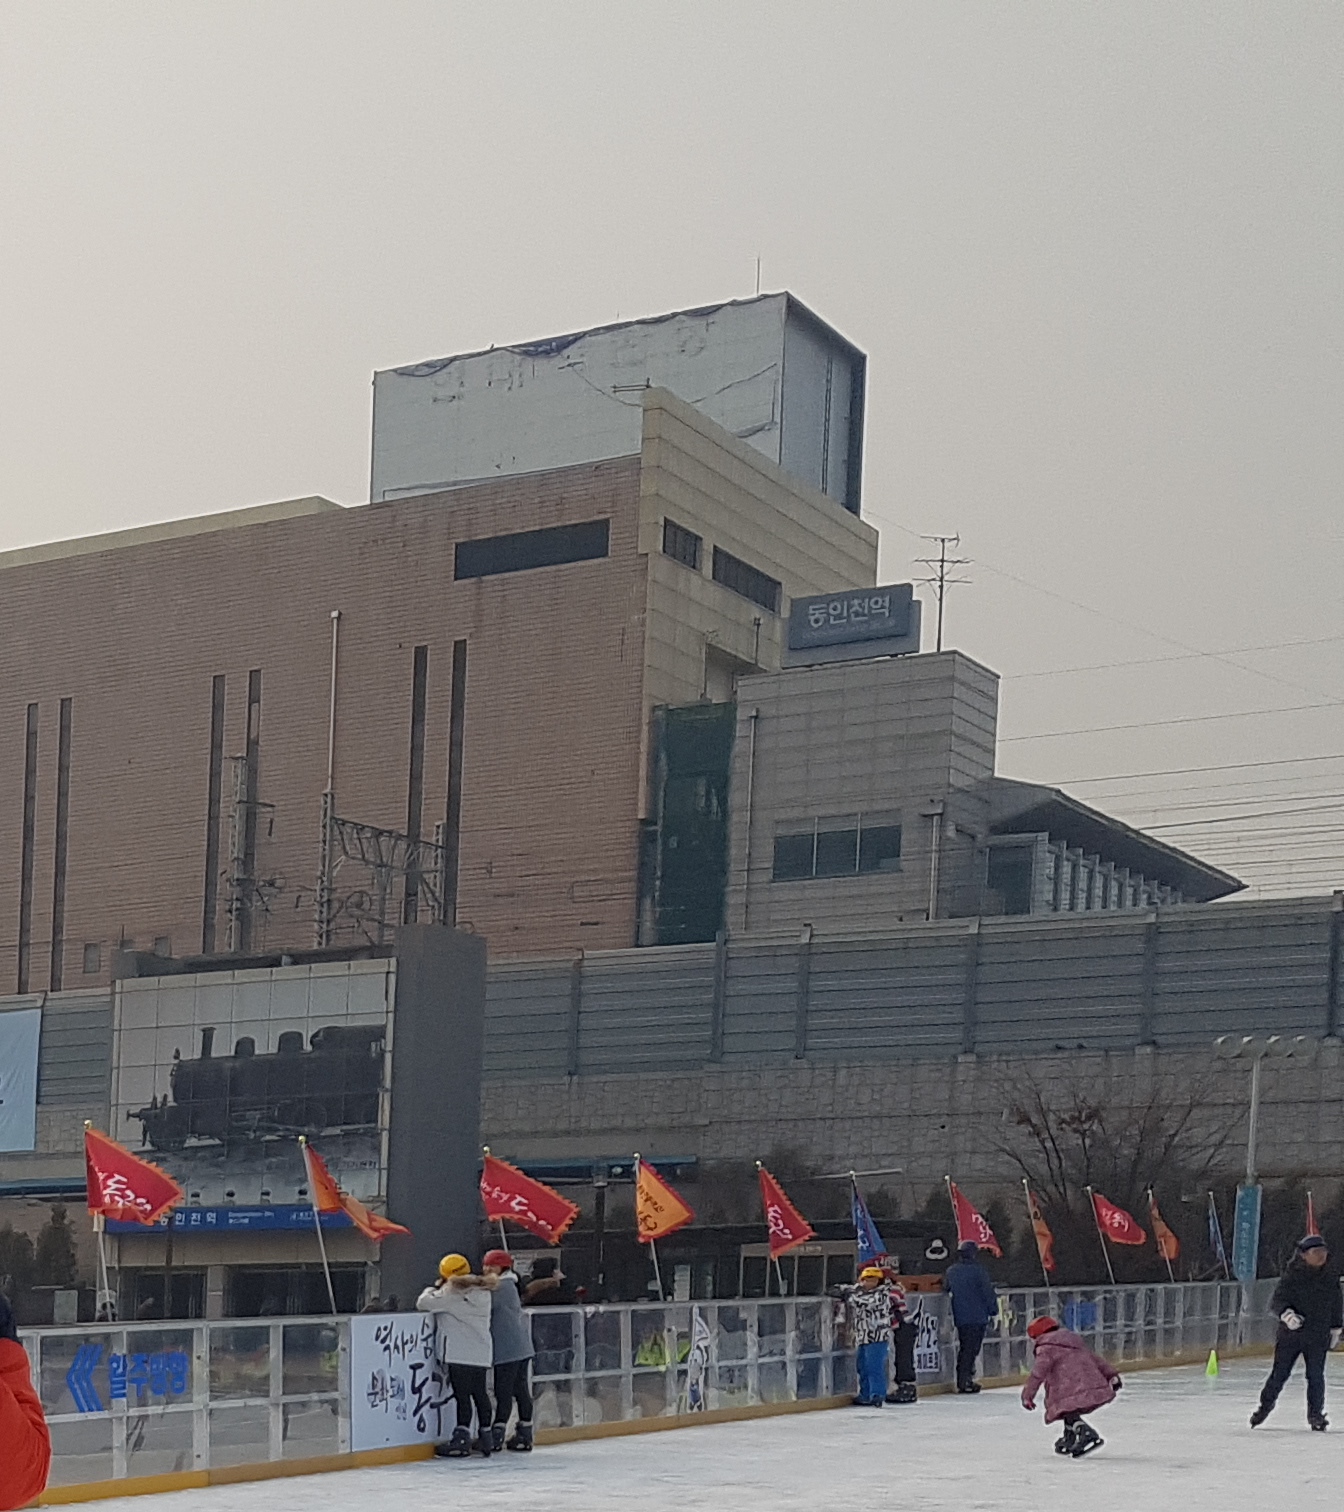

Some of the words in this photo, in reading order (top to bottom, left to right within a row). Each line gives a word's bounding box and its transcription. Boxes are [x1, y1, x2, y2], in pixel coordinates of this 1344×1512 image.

[808, 595, 891, 628] 동인천역
[375, 1320, 418, 1368] 역사의
[409, 1362, 455, 1436] 동구
